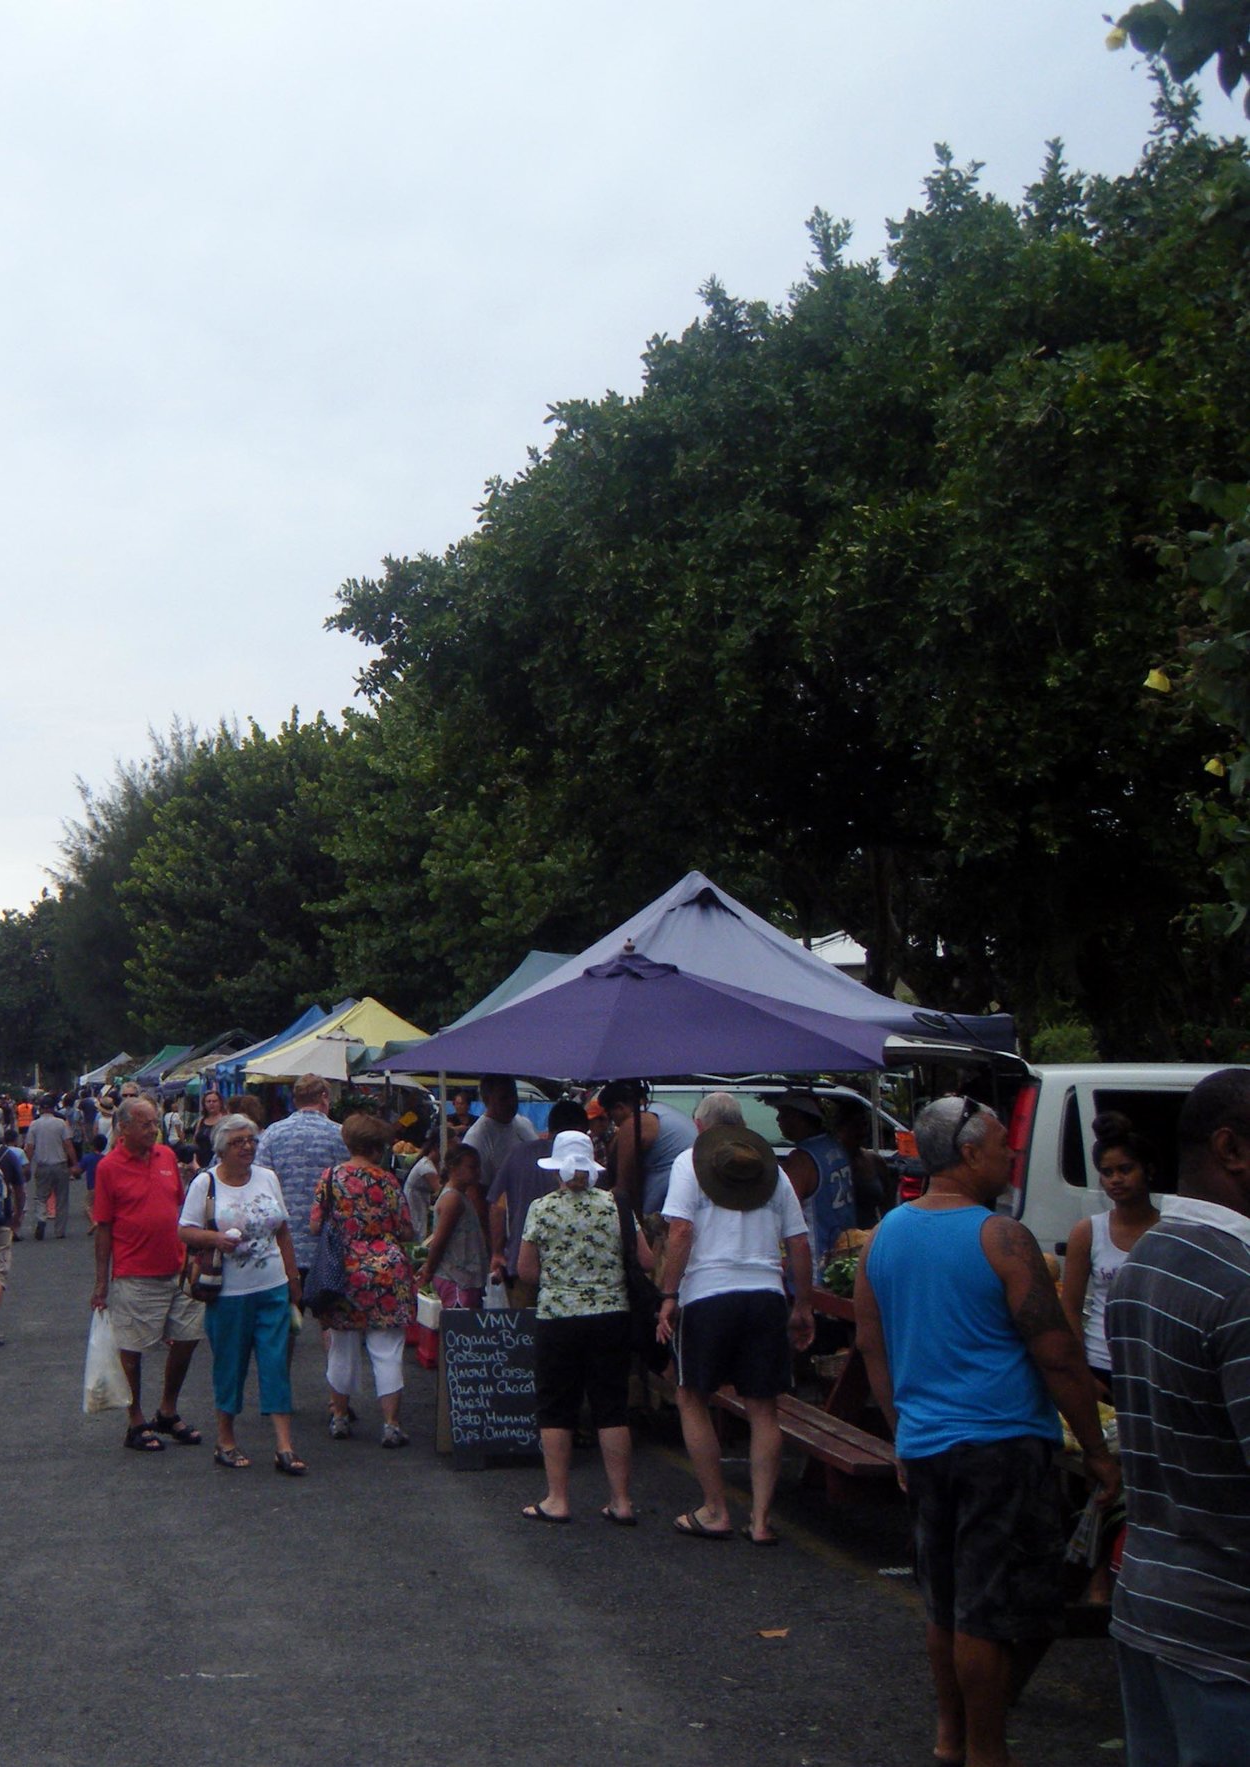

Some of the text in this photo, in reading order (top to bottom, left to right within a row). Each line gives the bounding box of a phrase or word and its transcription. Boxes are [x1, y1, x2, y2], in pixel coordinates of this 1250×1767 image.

[475, 1312, 520, 1329] VMV
[445, 1329, 500, 1353] Organic
[445, 1348, 508, 1364] Croissants
[447, 1363, 488, 1380] Almond
[451, 1395, 490, 1410] Muesli
